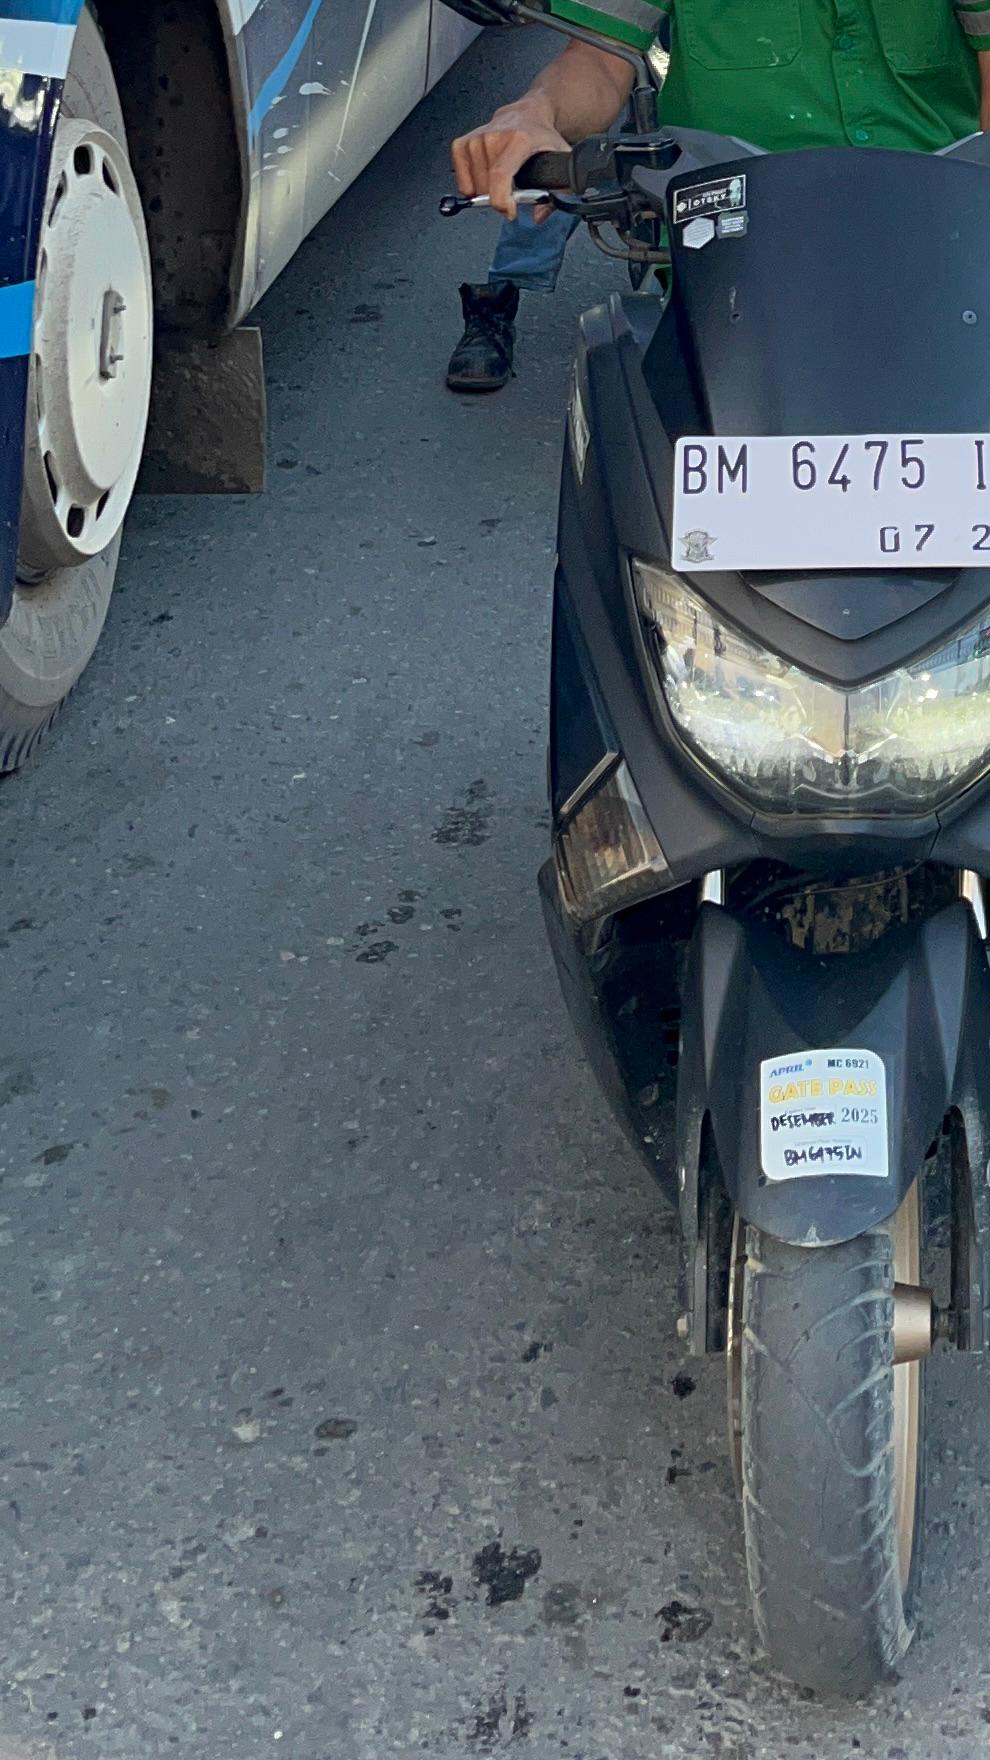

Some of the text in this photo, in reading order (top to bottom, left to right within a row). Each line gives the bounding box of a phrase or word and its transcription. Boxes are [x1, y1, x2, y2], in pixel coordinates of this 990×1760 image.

[682, 443, 749, 495] BM
[791, 439, 926, 493] 6475
[879, 523, 936, 553] 07
[827, 1058, 844, 1069] MC
[768, 1077, 879, 1104] GATE PASS
[840, 1106, 879, 1126] 2025
